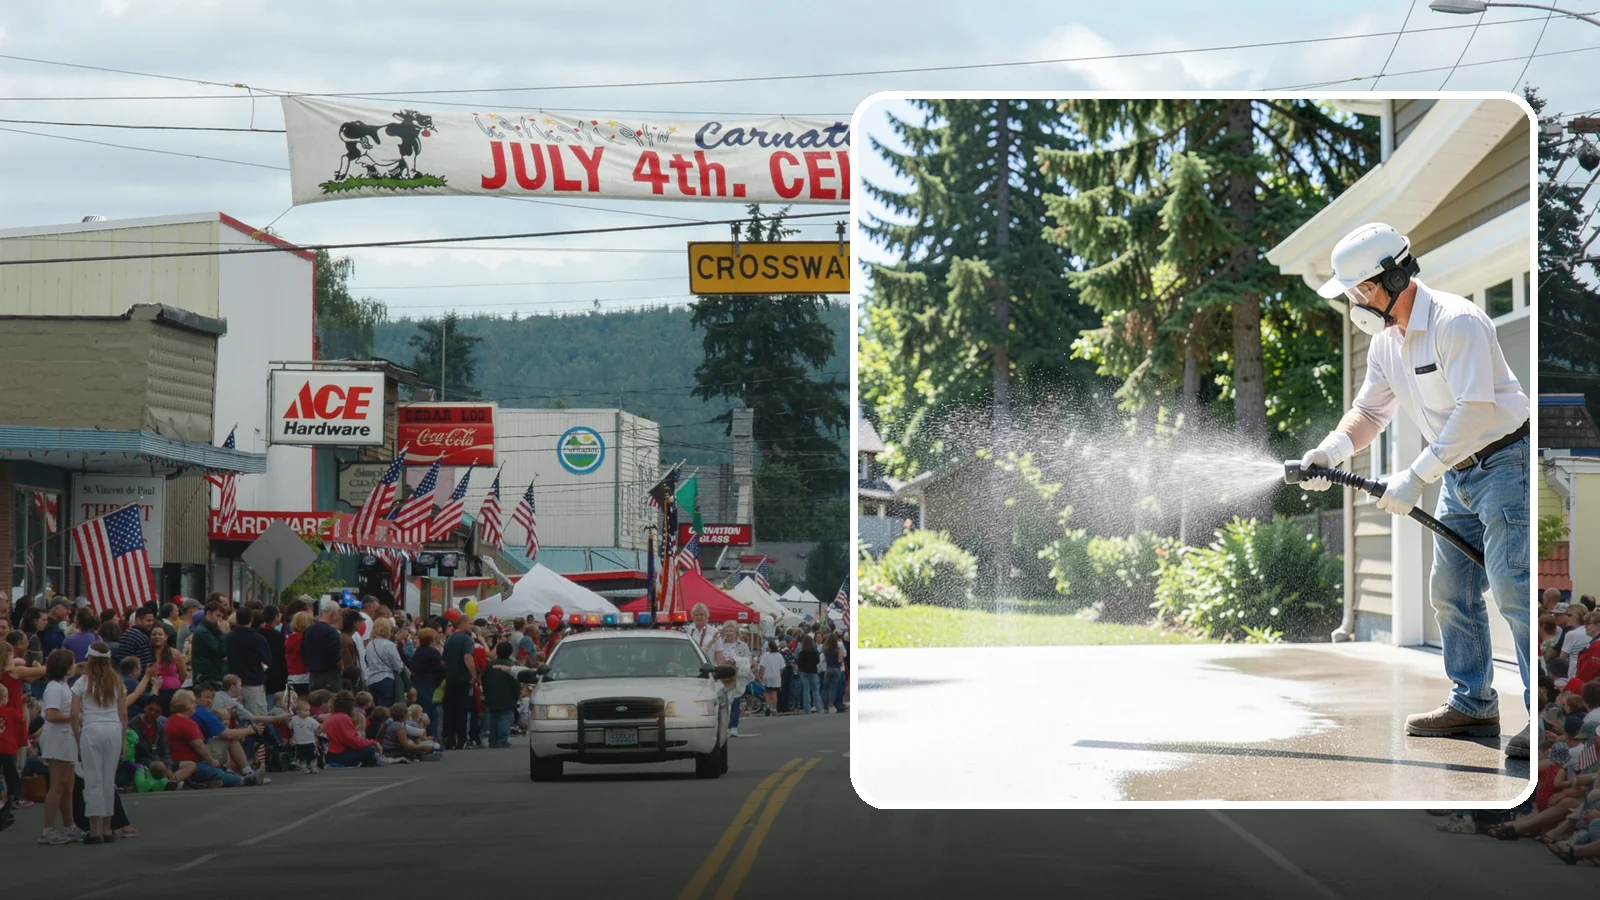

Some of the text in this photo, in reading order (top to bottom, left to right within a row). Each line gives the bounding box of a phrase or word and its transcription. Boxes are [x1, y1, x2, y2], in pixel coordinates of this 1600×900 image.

[481, 141, 605, 193] JULY
[632, 150, 746, 198] 4th.
[697, 254, 850, 280] CROSSWA
[282, 380, 374, 420] ACE
[405, 408, 453, 422] CEDAR
[283, 421, 371, 437] Hardware
[416, 428, 477, 447] Coca-Cola
[354, 467, 384, 480] Simpl
[83, 484, 155, 495] St. Vincent de Paul
[688, 526, 741, 535] CRNATION
[699, 535, 730, 543] GLASS
